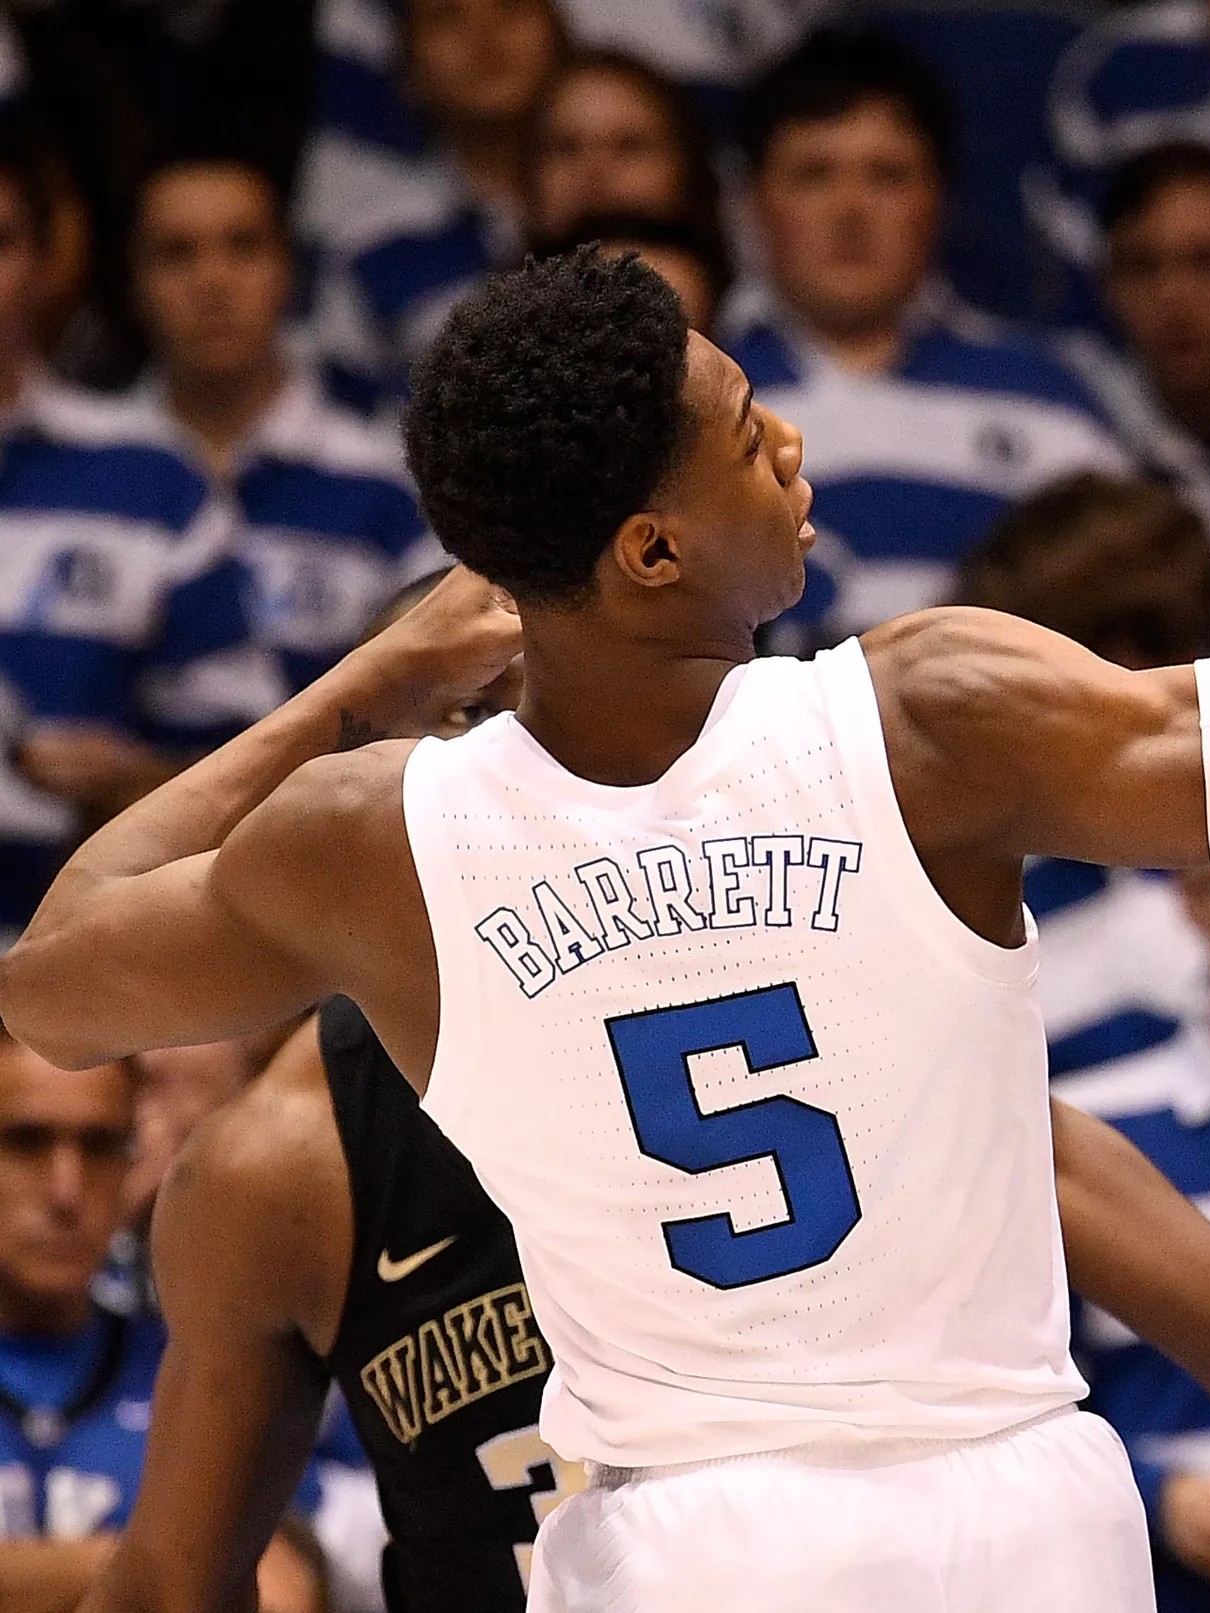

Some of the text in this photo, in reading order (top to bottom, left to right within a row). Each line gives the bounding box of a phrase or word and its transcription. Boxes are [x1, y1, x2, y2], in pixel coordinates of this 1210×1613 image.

[474, 834, 863, 999] BARRETT
[603, 980, 863, 1291] 5
[360, 1282, 548, 1444] WAKE
